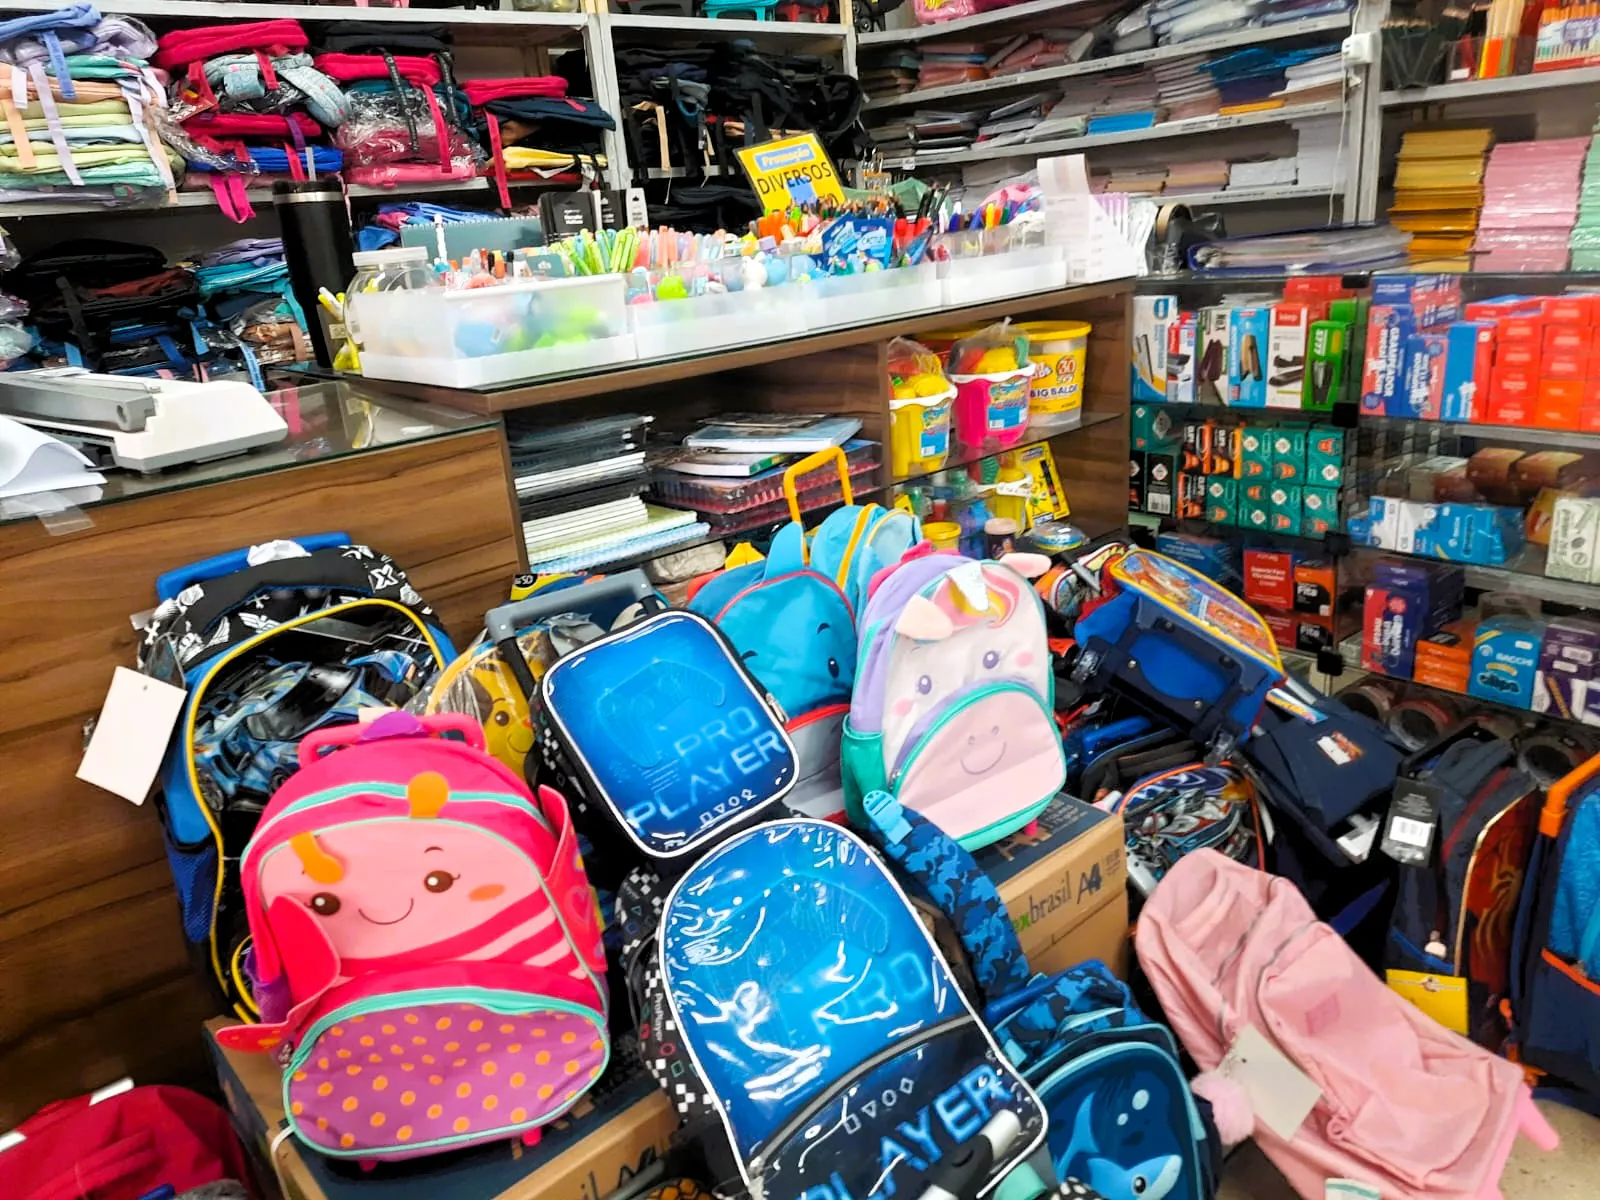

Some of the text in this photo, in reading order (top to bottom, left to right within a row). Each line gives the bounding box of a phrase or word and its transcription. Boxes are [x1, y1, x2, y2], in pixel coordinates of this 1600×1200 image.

[757, 162, 832, 195] DIVERSOS
[1058, 358, 1076, 373] 30
[1030, 387, 1049, 398] BIG
[1297, 584, 1319, 598] Fita
[674, 706, 760, 765] PRO
[624, 729, 787, 836] PLAYER
[1076, 862, 1103, 905] A4
